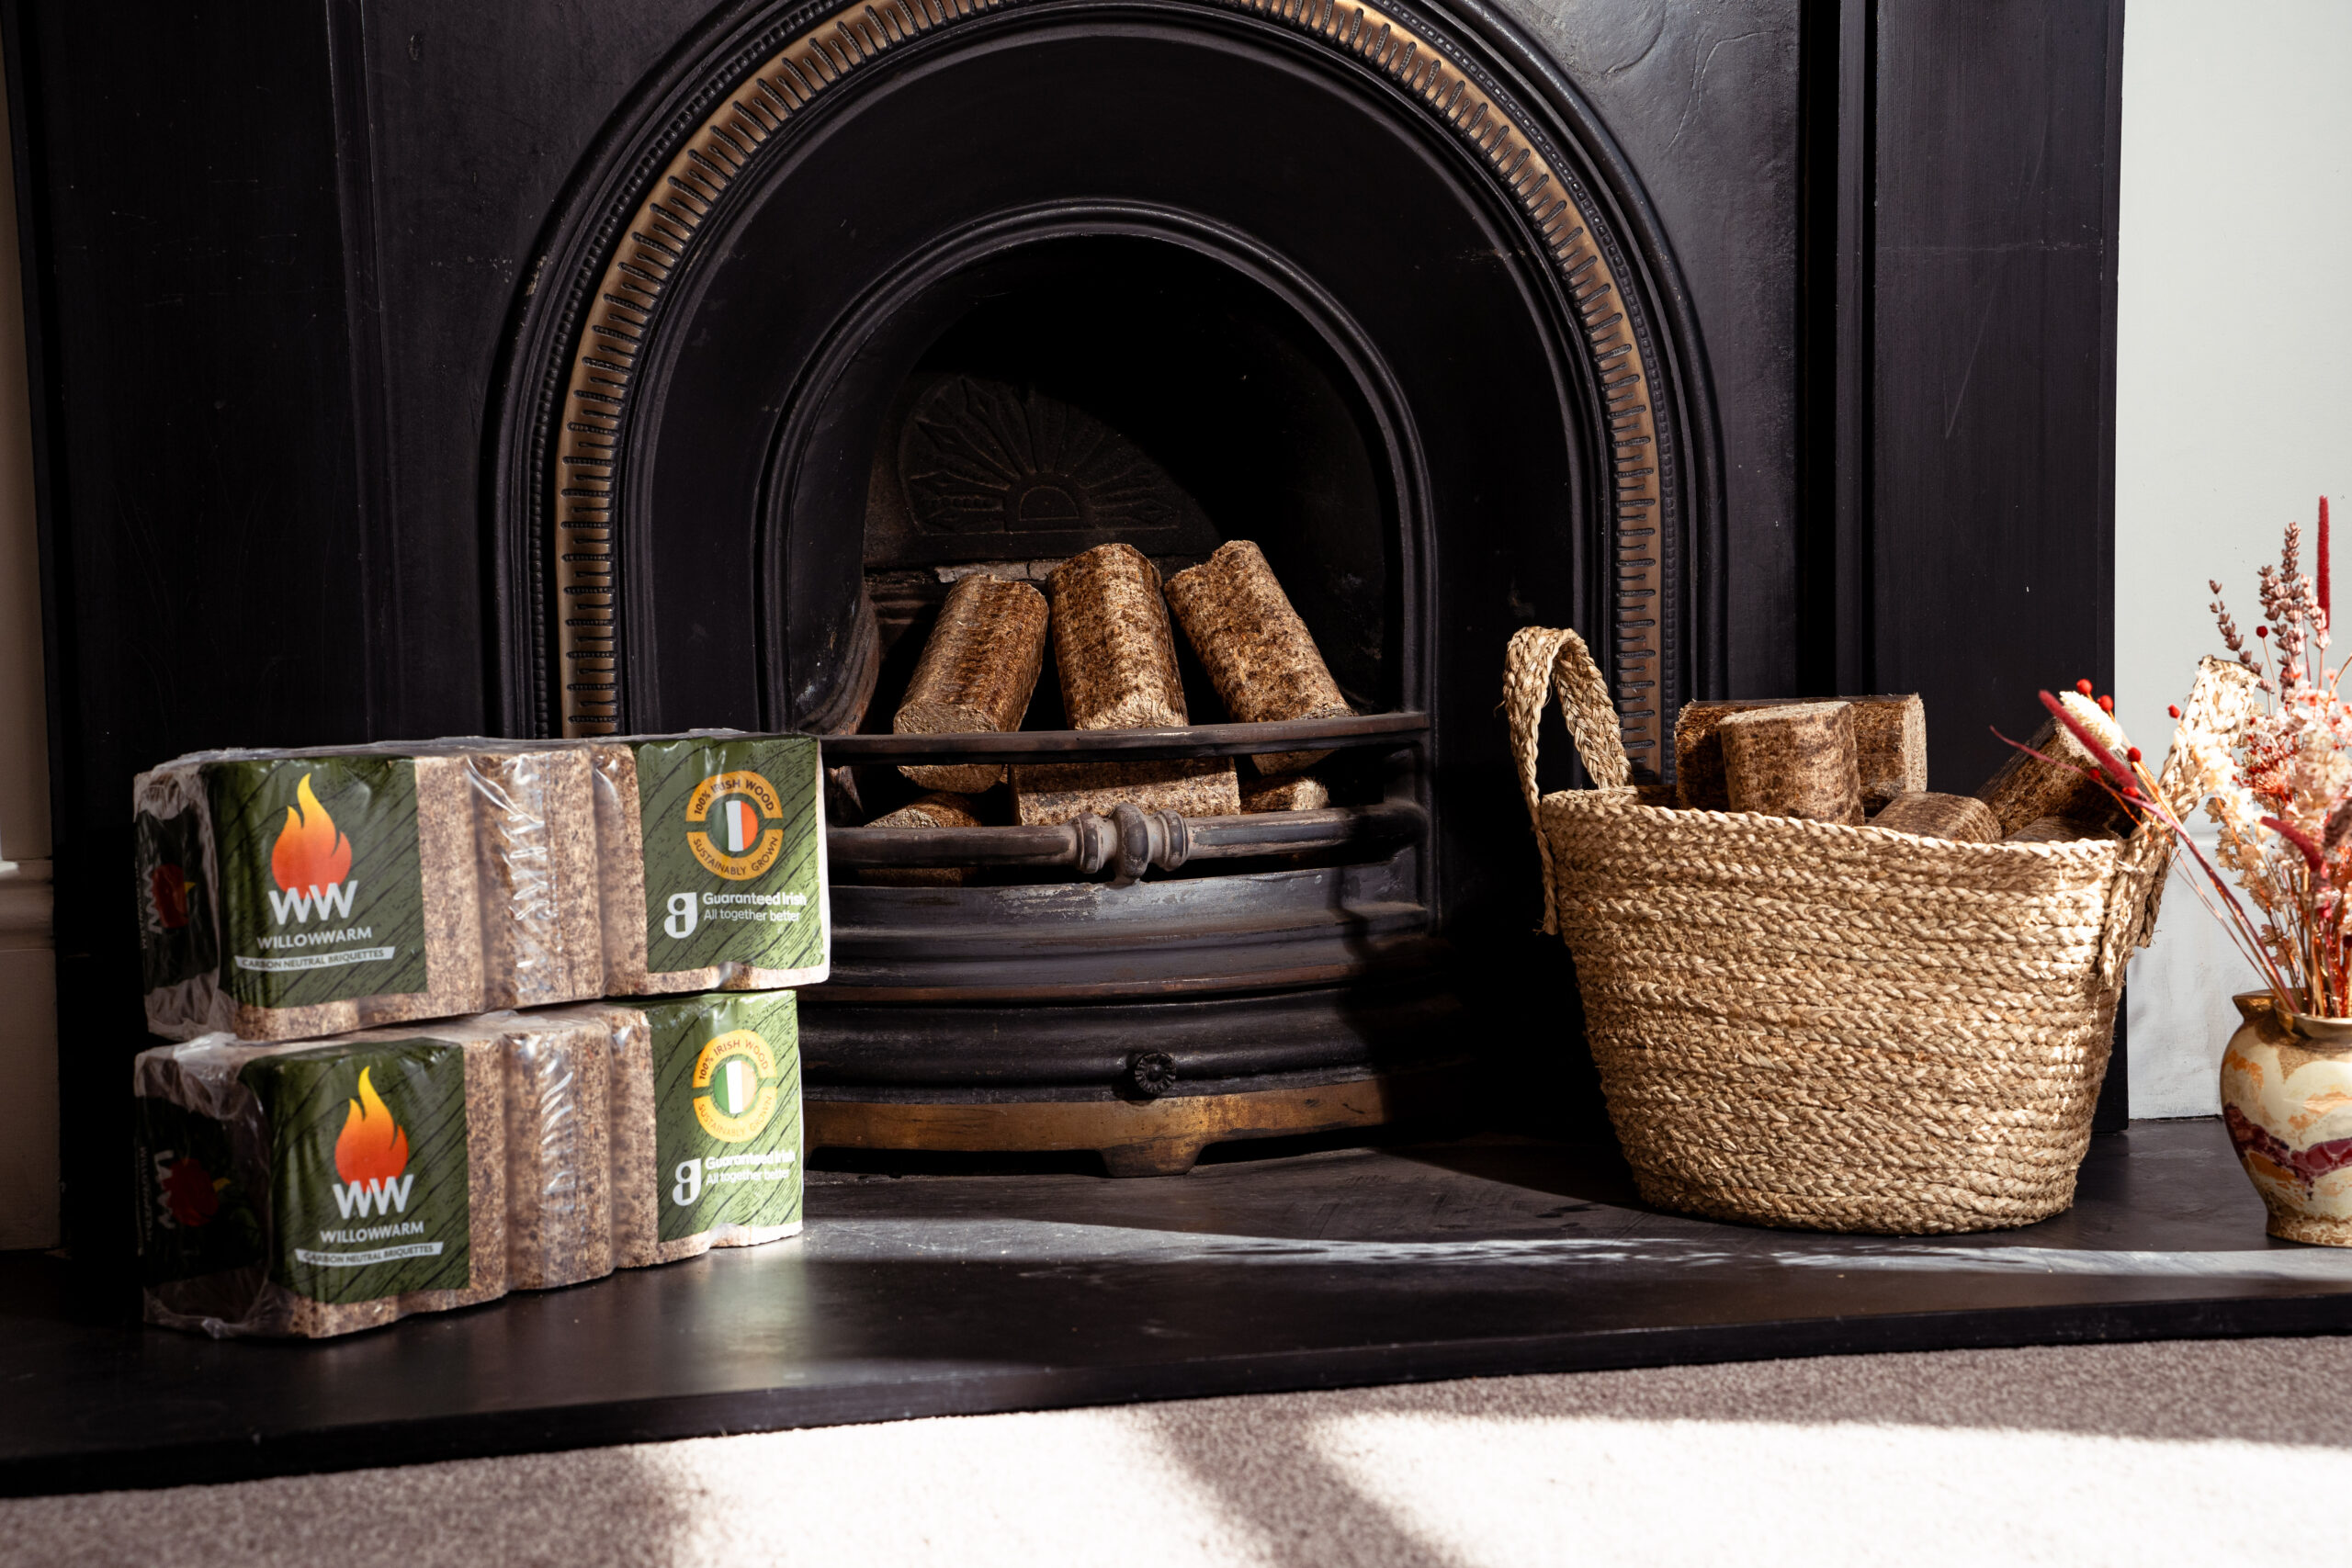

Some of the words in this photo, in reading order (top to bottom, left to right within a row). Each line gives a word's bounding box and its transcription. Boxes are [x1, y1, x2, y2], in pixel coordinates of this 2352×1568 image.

[710, 779, 741, 794] IRISH
[745, 779, 775, 811] WOOD
[693, 838, 747, 875] SUSTAINABLY
[751, 837, 778, 872] GROWN
[268, 880, 358, 925] WW
[703, 892, 780, 906] Guaranteed
[782, 892, 807, 906] Irish
[704, 909, 717, 920] All
[720, 908, 767, 921] together
[770, 909, 801, 922] better
[257, 926, 372, 949] WILLOWWARM
[283, 955, 325, 968] NEUTRAL
[328, 949, 384, 964] BRIQUETTES
[713, 1039, 741, 1056] IRISH
[745, 1039, 769, 1070] WOOD
[706, 1172, 718, 1186] All
[719, 1168, 763, 1183] together
[332, 1174, 414, 1220] WW
[320, 1221, 424, 1243] WILLOWWARM
[345, 1251, 381, 1263] NEUTRAL
[383, 1245, 434, 1259] BRIQUETTES
